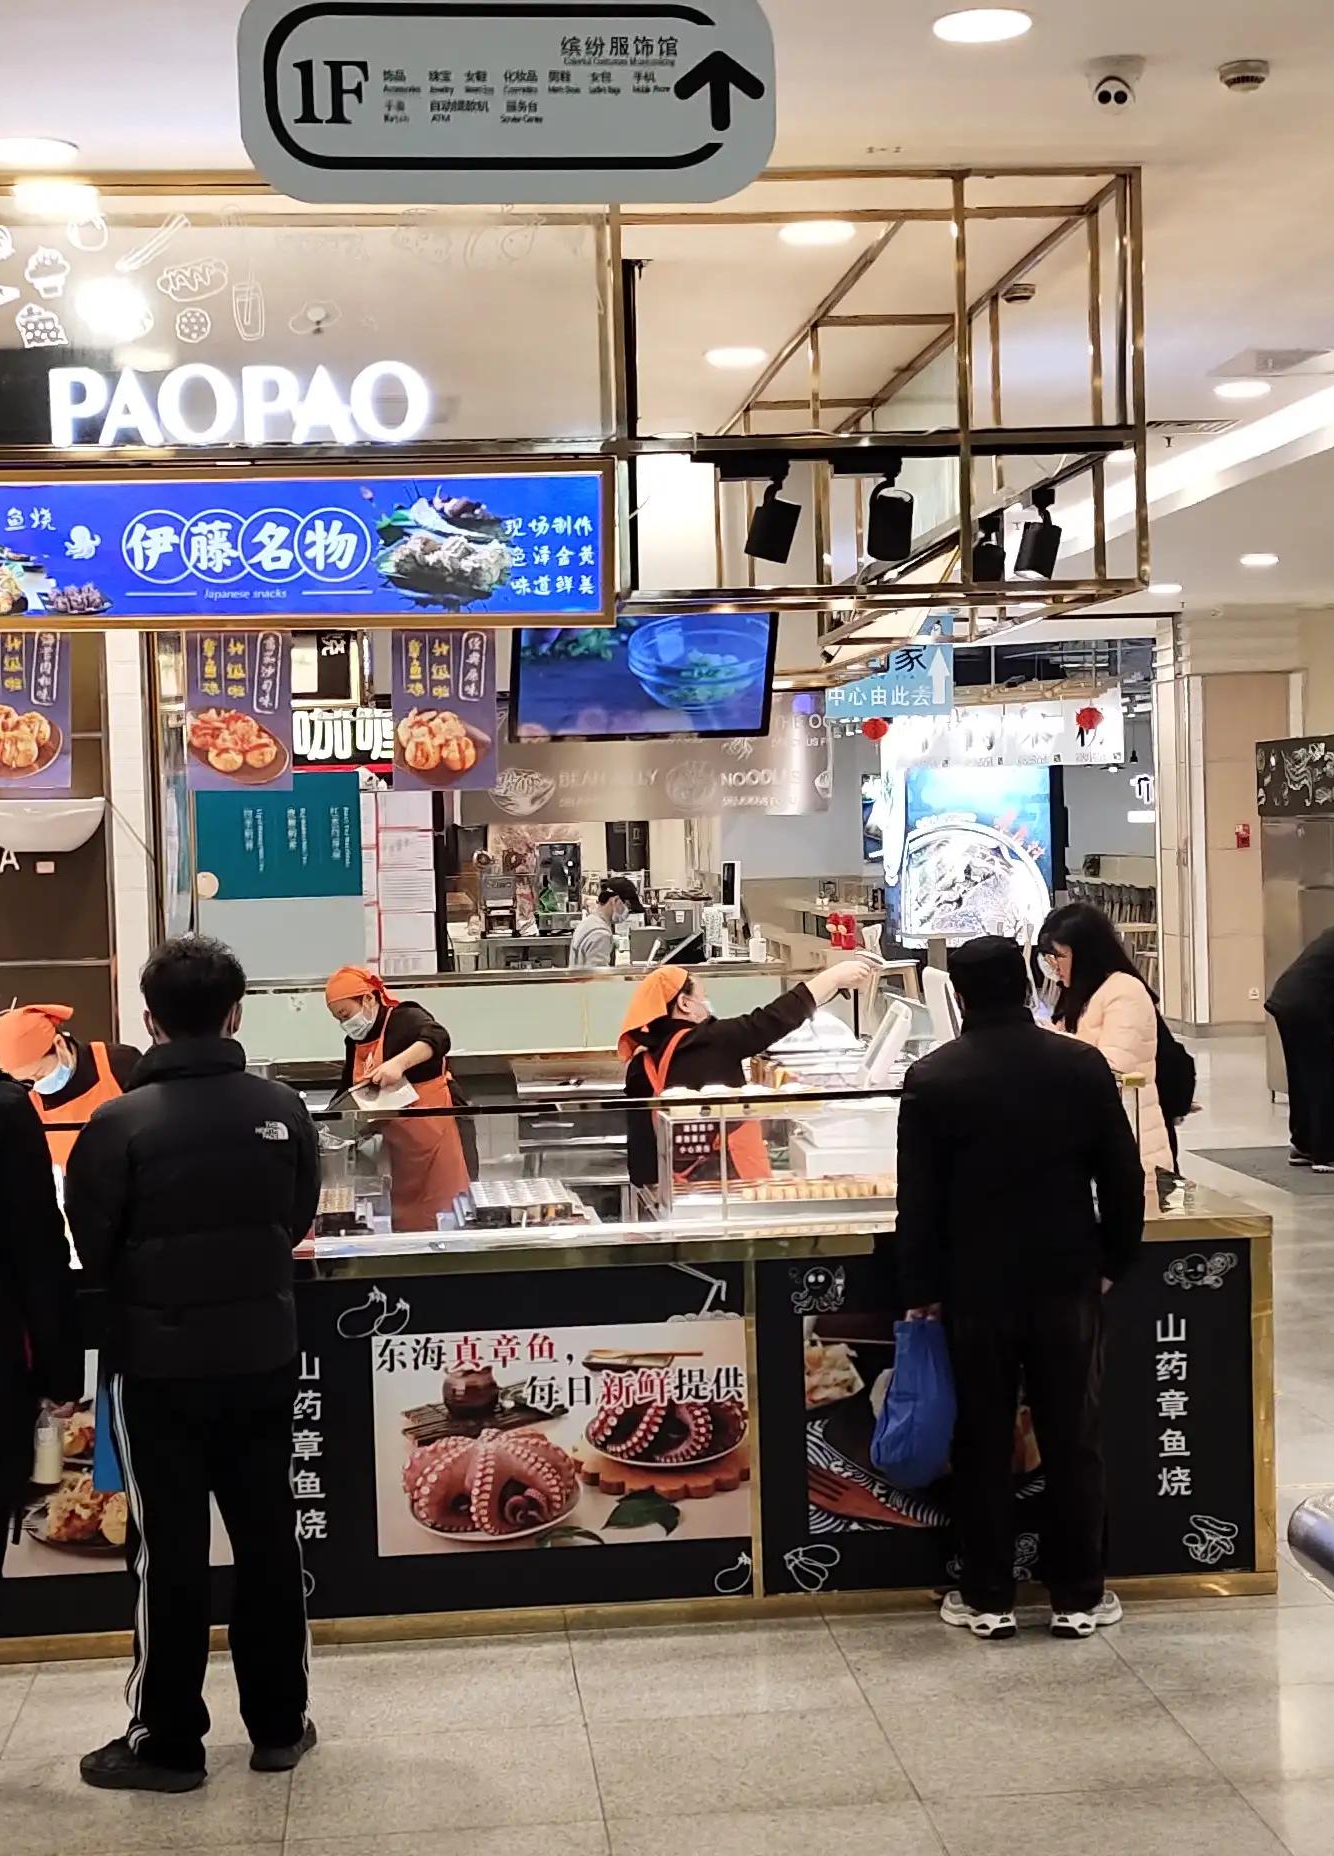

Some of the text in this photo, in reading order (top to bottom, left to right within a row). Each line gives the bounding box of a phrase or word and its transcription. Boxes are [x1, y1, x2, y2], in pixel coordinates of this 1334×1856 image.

[560, 36, 679, 57] 缤纷服饰馆
[292, 60, 369, 125] 1F
[48, 360, 430, 447] PAOPAO
[504, 515, 594, 537] 现场制作
[127, 521, 359, 573] 伊藤名物
[510, 544, 595, 567] 色泽金黄
[509, 575, 595, 597] 味道鲜美
[827, 684, 933, 706] 中心由此去
[374, 1332, 575, 1373] 东海真章鱼，
[524, 1366, 746, 1409] 每日新鲜提供
[1154, 1313, 1193, 1497] 山药章鱼烧
